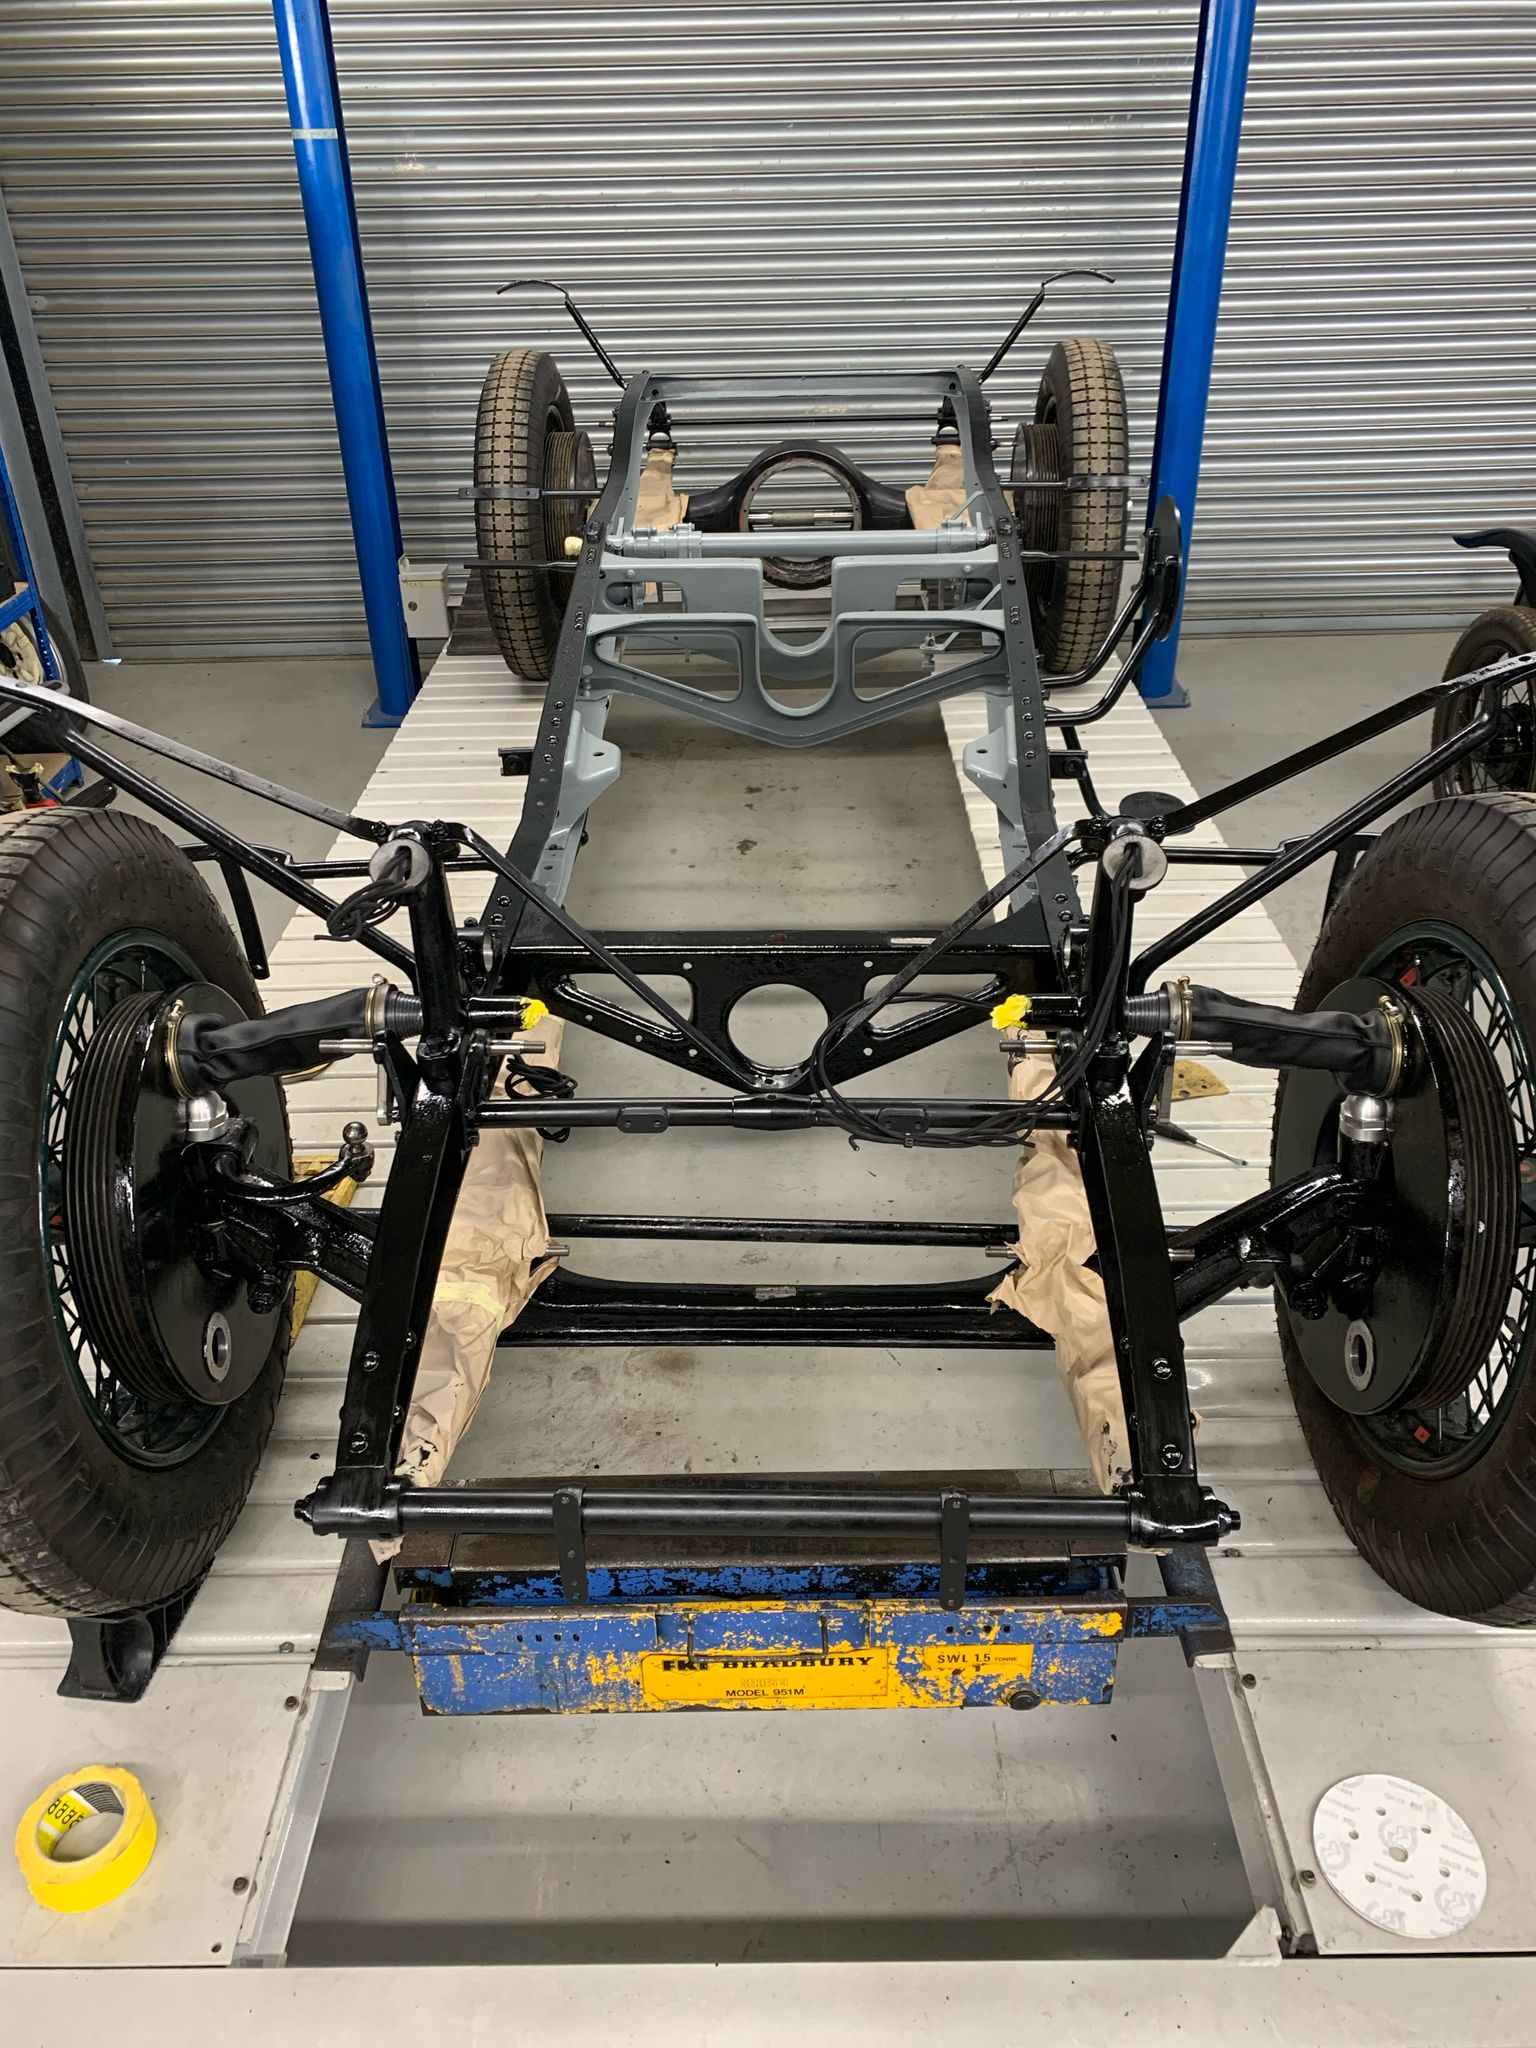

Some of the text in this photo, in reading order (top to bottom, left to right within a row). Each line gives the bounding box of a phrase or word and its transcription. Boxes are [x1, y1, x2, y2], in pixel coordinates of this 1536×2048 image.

[723, 1657, 874, 1669] BRADBURY
[937, 1654, 968, 1664] SWL
[974, 1653, 991, 1663] 1.5
[741, 1678, 777, 1688] SERIES
[725, 1688, 804, 1697] MODEL 951M
